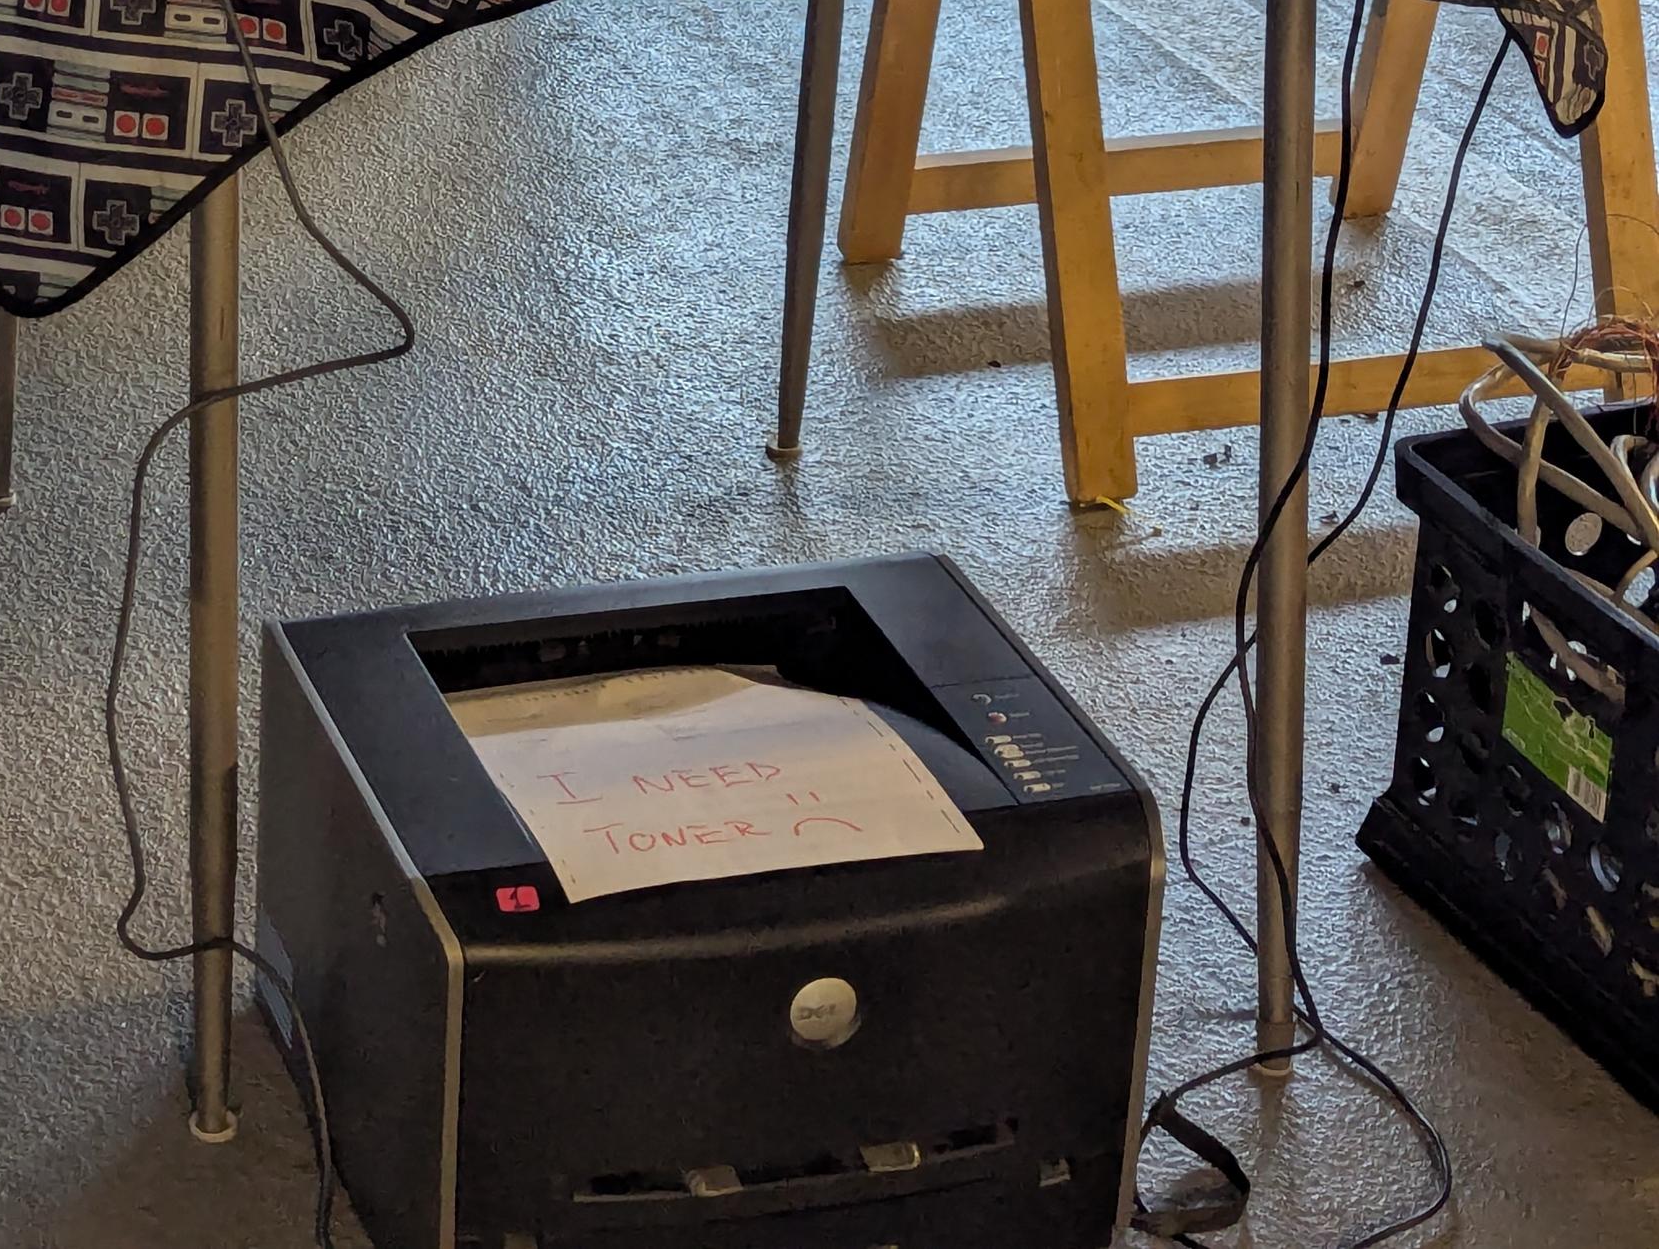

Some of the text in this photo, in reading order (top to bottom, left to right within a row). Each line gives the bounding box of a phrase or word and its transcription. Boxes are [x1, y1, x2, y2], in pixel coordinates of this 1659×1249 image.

[539, 760, 783, 805] I NEED
[583, 817, 772, 855] TONER
